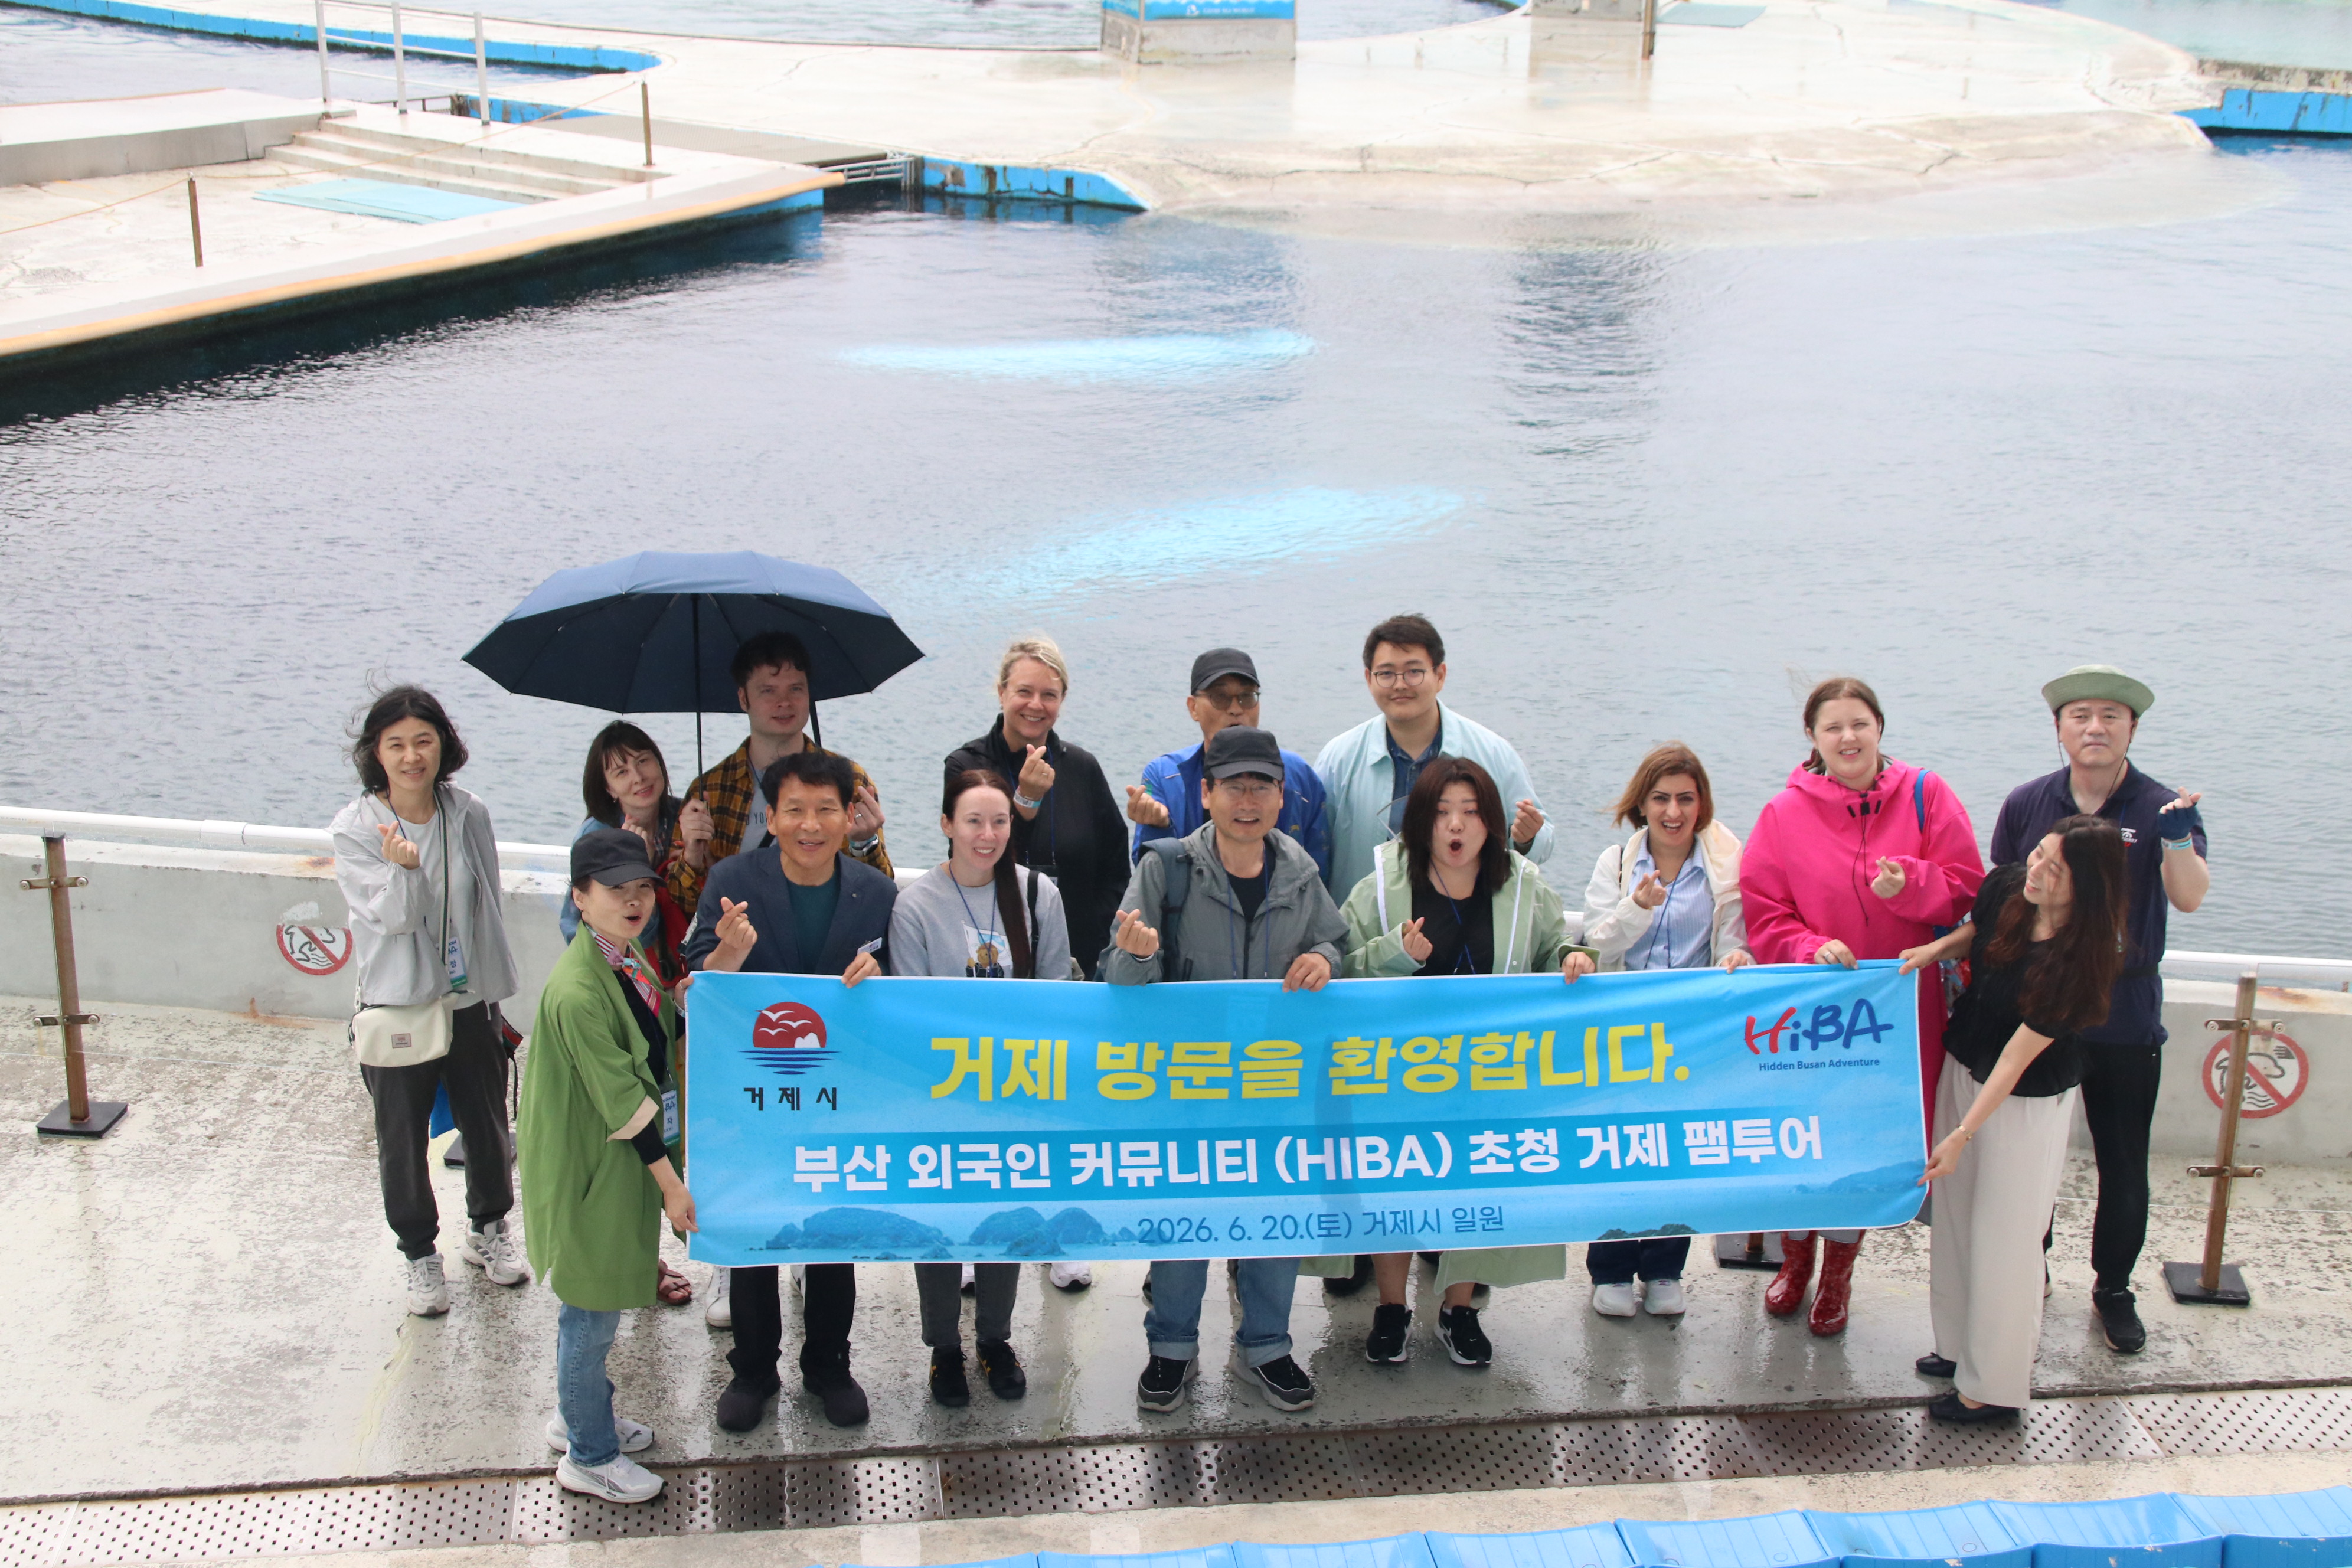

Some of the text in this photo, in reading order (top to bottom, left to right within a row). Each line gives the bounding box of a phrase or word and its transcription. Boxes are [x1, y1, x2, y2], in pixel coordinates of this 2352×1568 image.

[754, 812, 767, 824] YO
[931, 1023, 1690, 1101] 거제 방문을 환영합니다.
[1759, 1057, 1880, 1072] Hidden Busan Adventure
[793, 1115, 1823, 1193] 부산 외국인 커뮤니티 (HIBA) 초청 거제 팸투어
[1137, 1206, 1504, 1243] 2026. 6. 20.(토) 거제시 일원
